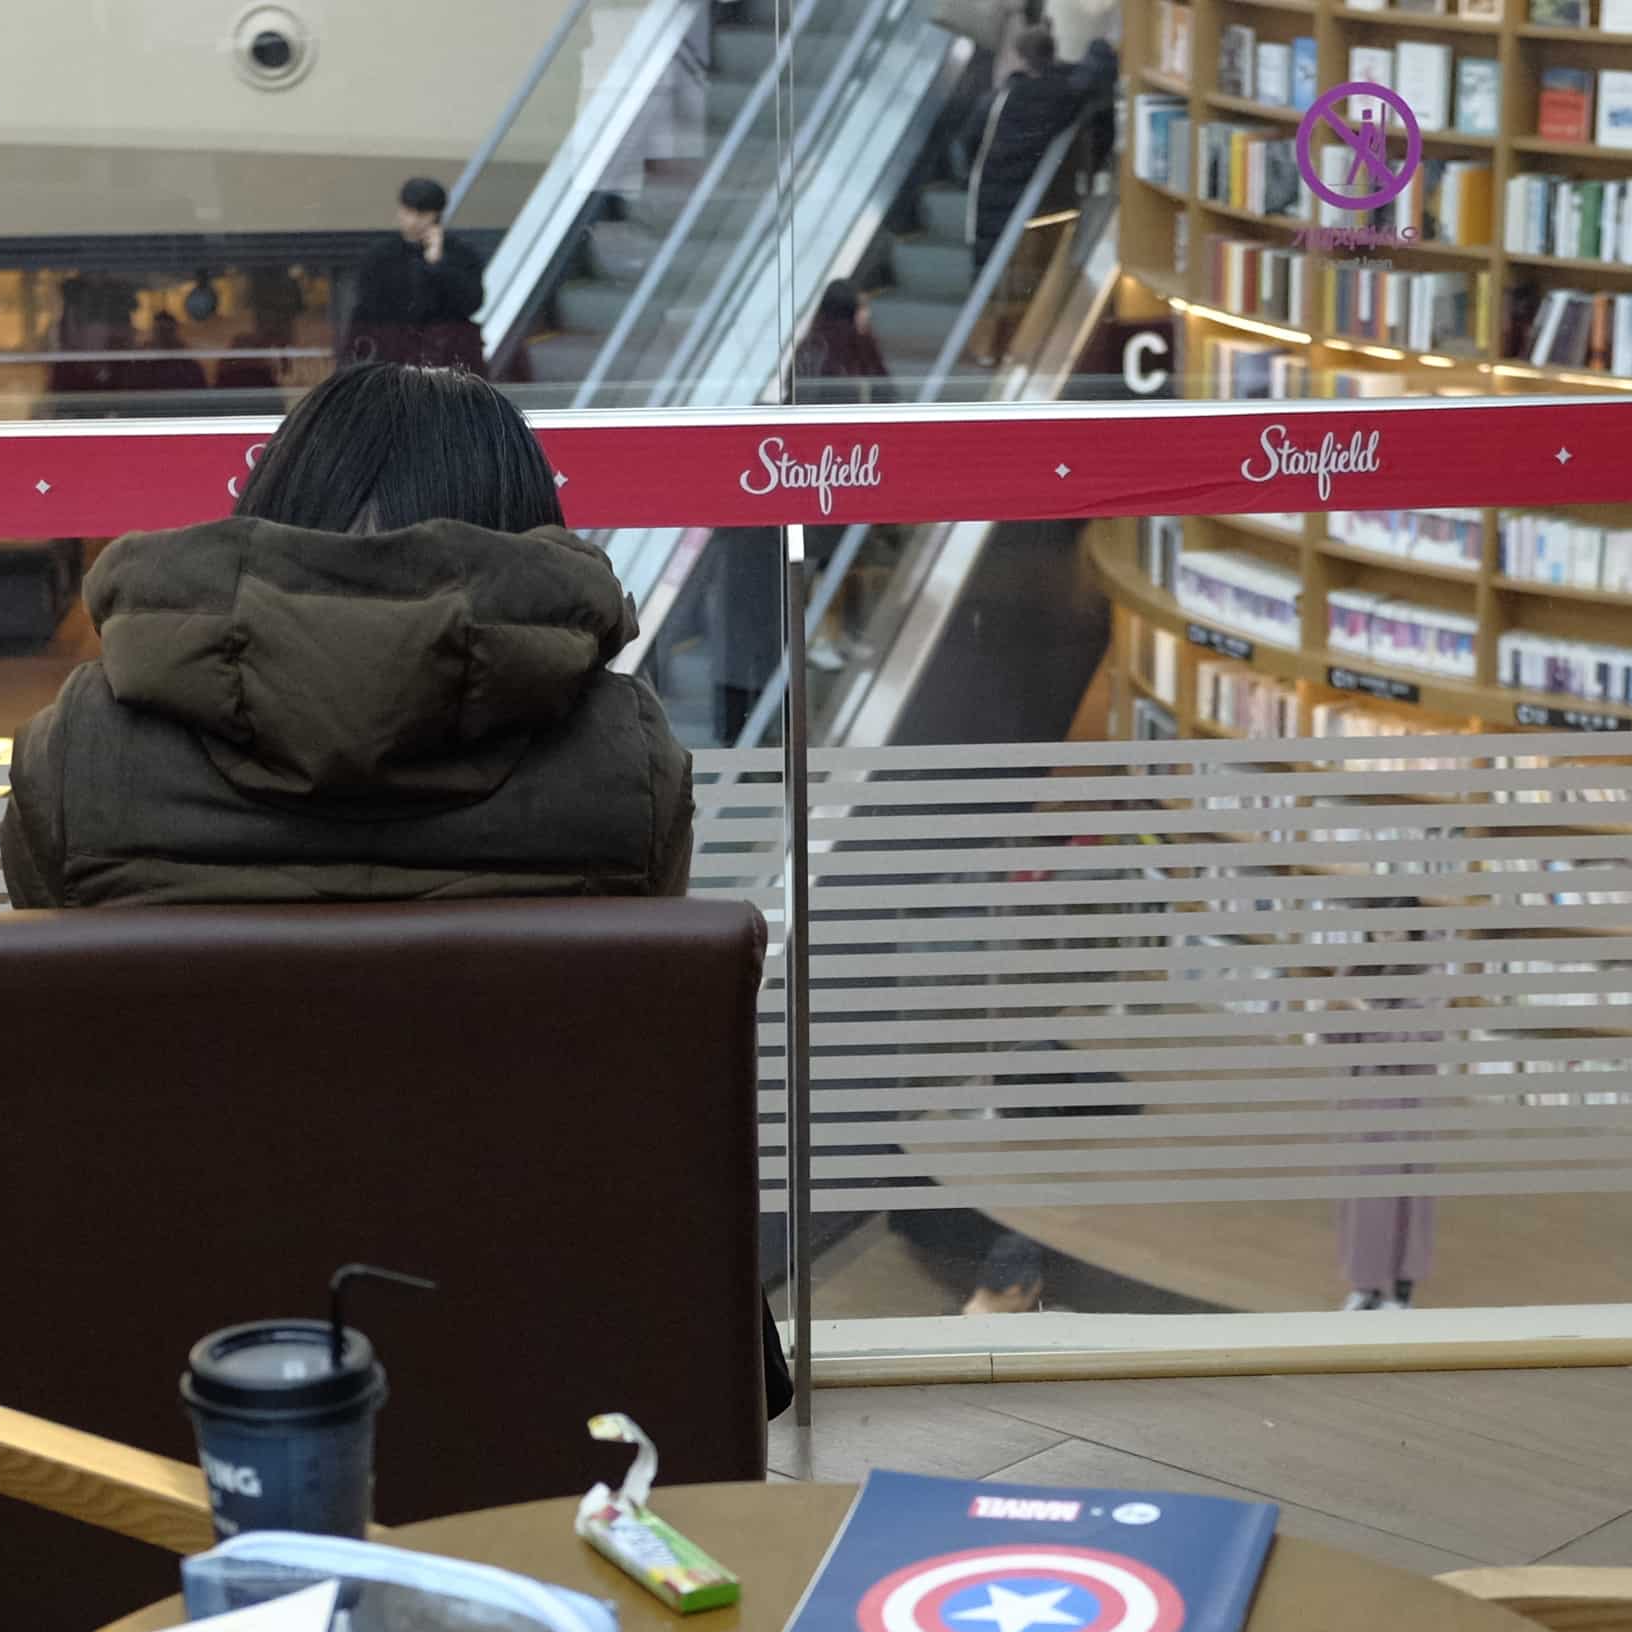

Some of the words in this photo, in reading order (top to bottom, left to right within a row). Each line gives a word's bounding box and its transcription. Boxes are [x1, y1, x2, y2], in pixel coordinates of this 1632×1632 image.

[1122, 331, 1169, 394] C
[739, 435, 881, 516] Starfield
[1241, 424, 1380, 501] Starfield
